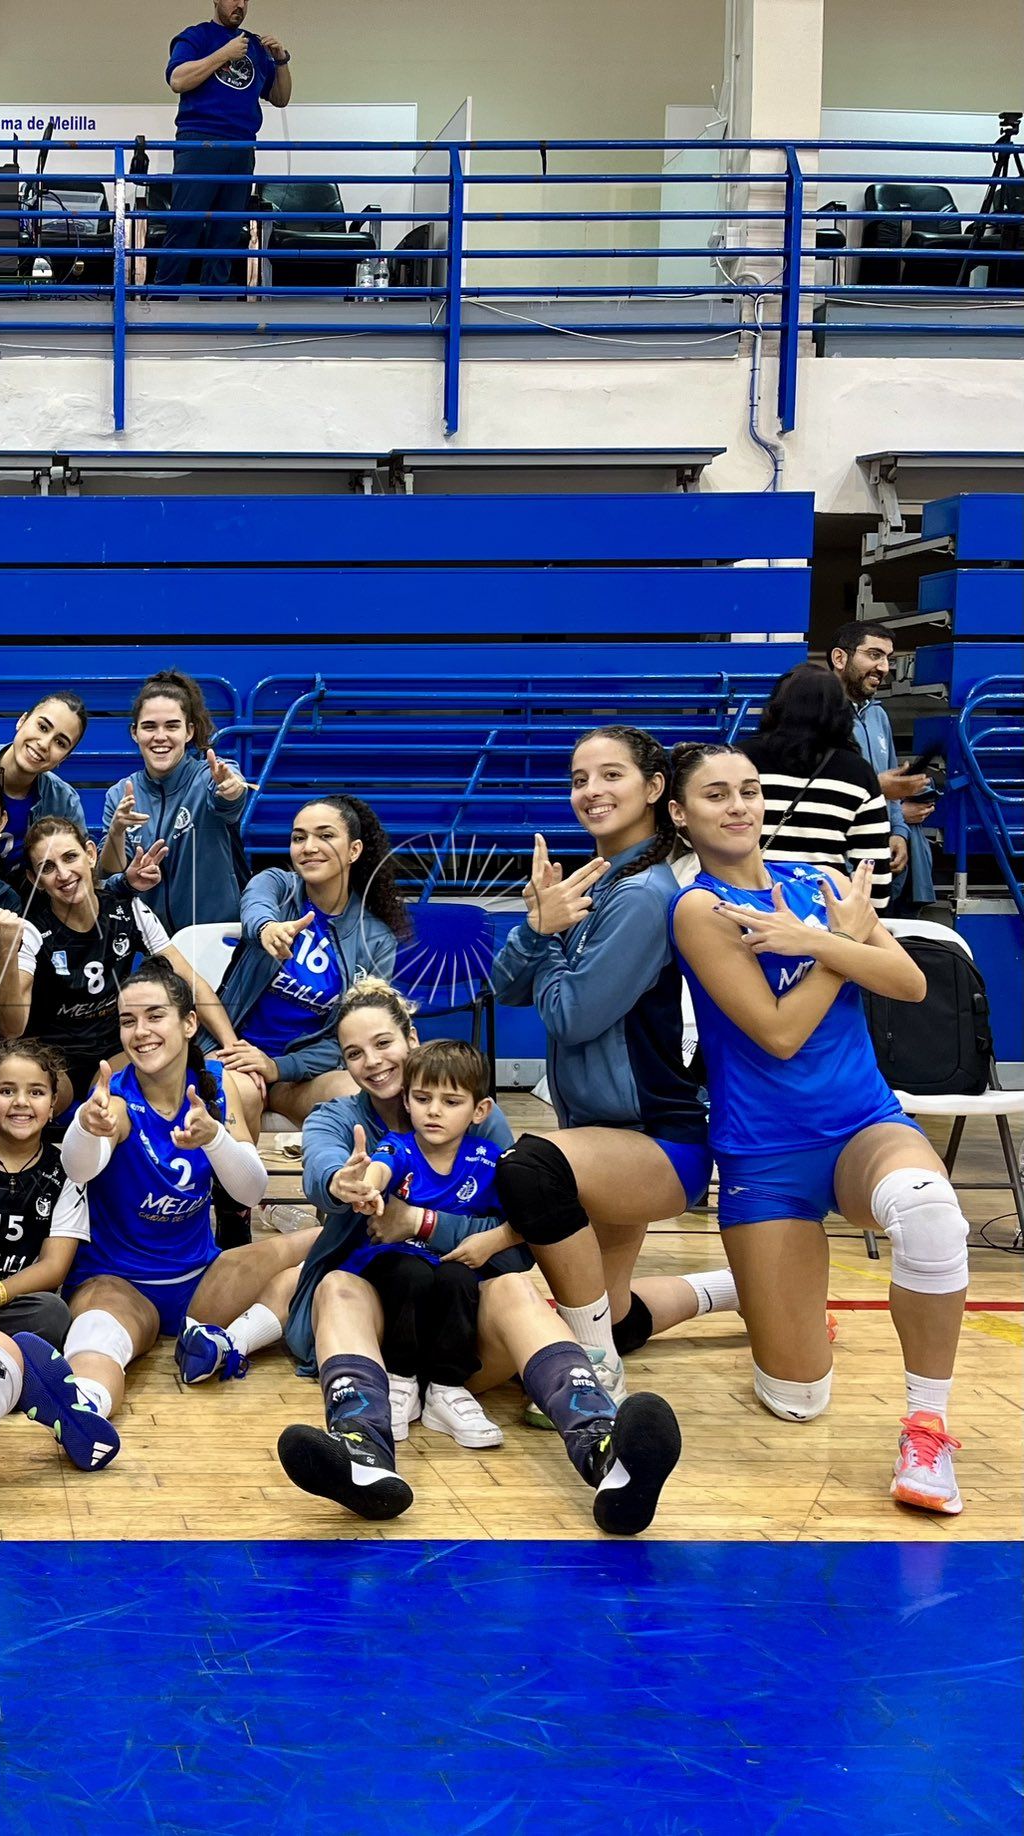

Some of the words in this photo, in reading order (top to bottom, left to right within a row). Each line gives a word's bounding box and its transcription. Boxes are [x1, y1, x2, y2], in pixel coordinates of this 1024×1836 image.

[27, 116, 44, 131] de
[49, 116, 96, 131] Melilla
[296, 928, 330, 974] 16
[83, 961, 105, 994] 8
[270, 971, 340, 1011] ELILLA
[170, 1157, 196, 1192] 2
